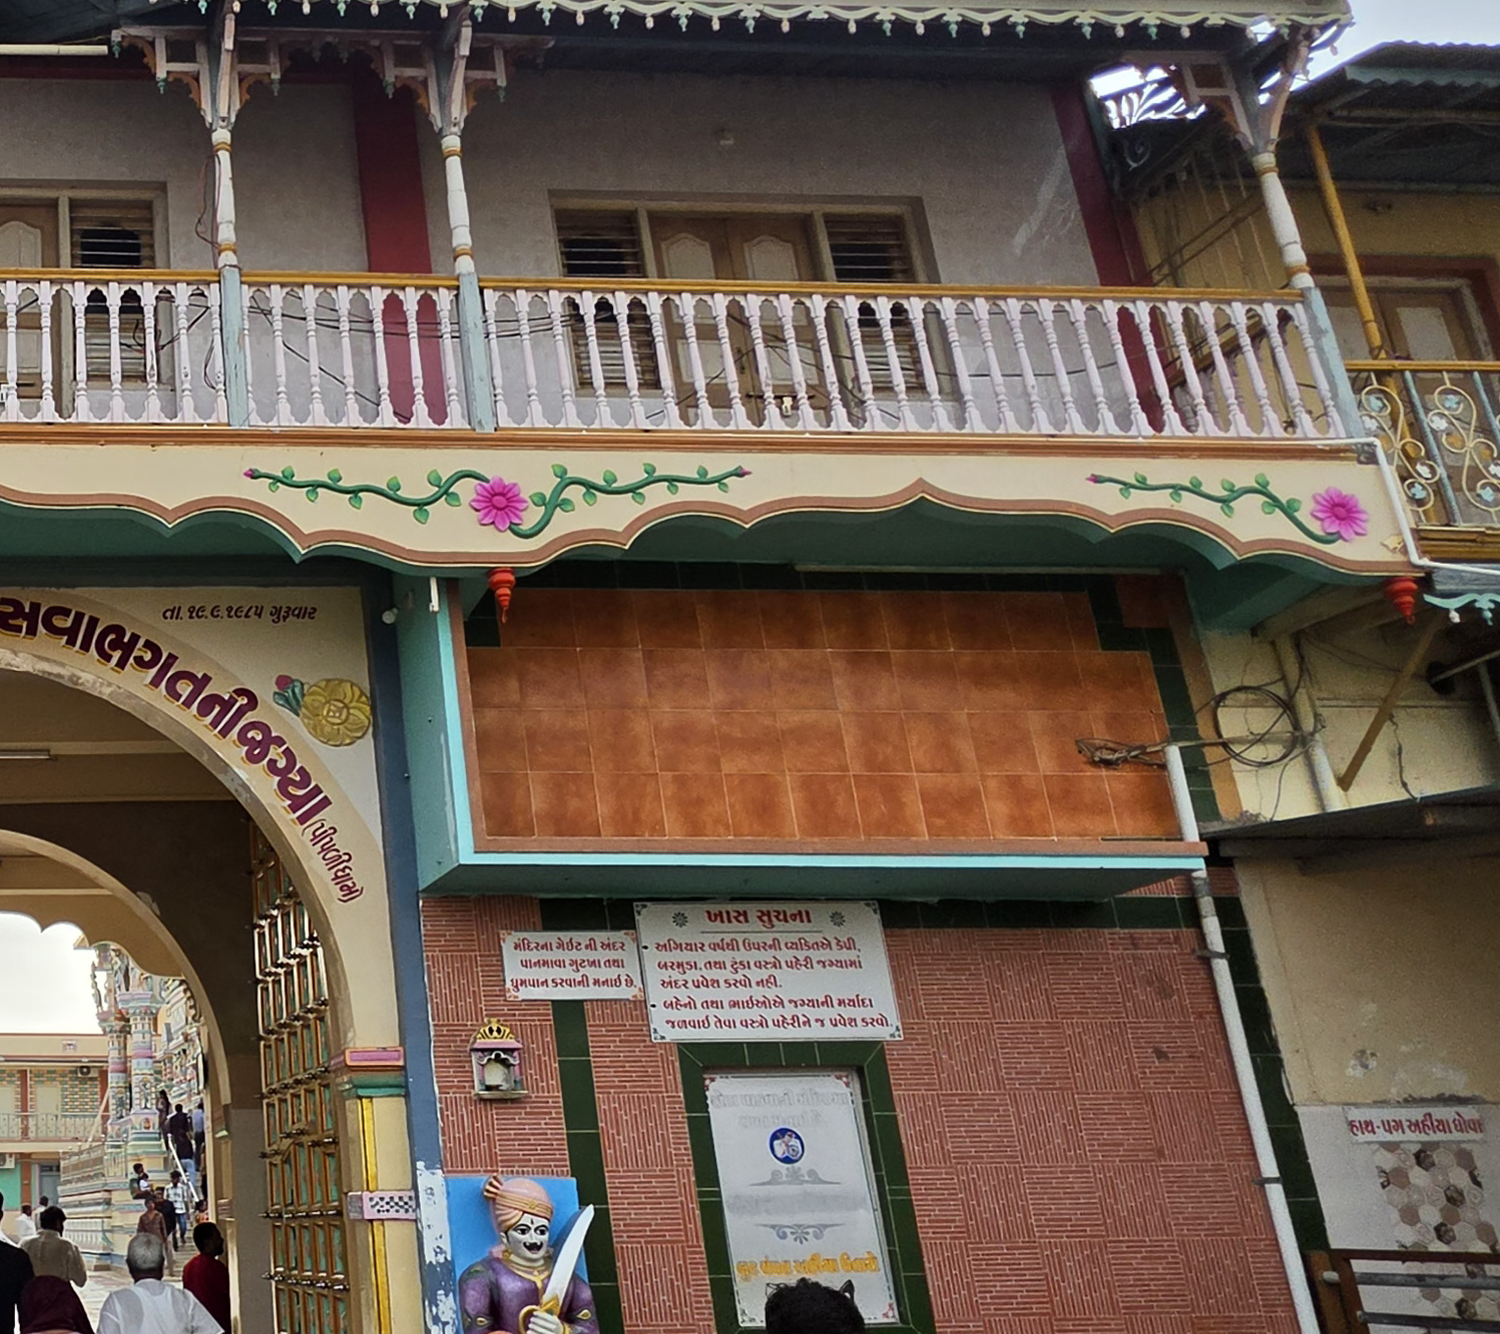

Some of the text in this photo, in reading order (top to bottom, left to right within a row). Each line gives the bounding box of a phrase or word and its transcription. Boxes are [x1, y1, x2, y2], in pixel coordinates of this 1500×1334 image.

[705, 909, 812, 929] ખાસ સુચના
[513, 937, 553, 952] મંદિરના
[600, 937, 626, 952] અંદર
[655, 938, 706, 953] અગિયાર
[742, 937, 783, 952] ઉપરની
[568, 958, 601, 973] ગુટખા
[603, 958, 625, 969] તથા
[703, 960, 727, 971] તથા
[785, 955, 814, 971] પહેરી
[551, 973, 590, 988] કરવાની
[660, 975, 689, 989] અંદર
[723, 973, 753, 989] કરવો
[663, 995, 697, 1011] બહેનો
[700, 999, 724, 1010] તથા
[788, 994, 834, 1009] જગ્યાની
[836, 993, 874, 1009] મર્યાદા
[713, 1014, 736, 1029] તેવા
[772, 1013, 811, 1030] પહેરીને
[814, 1017, 826, 1028] જ
